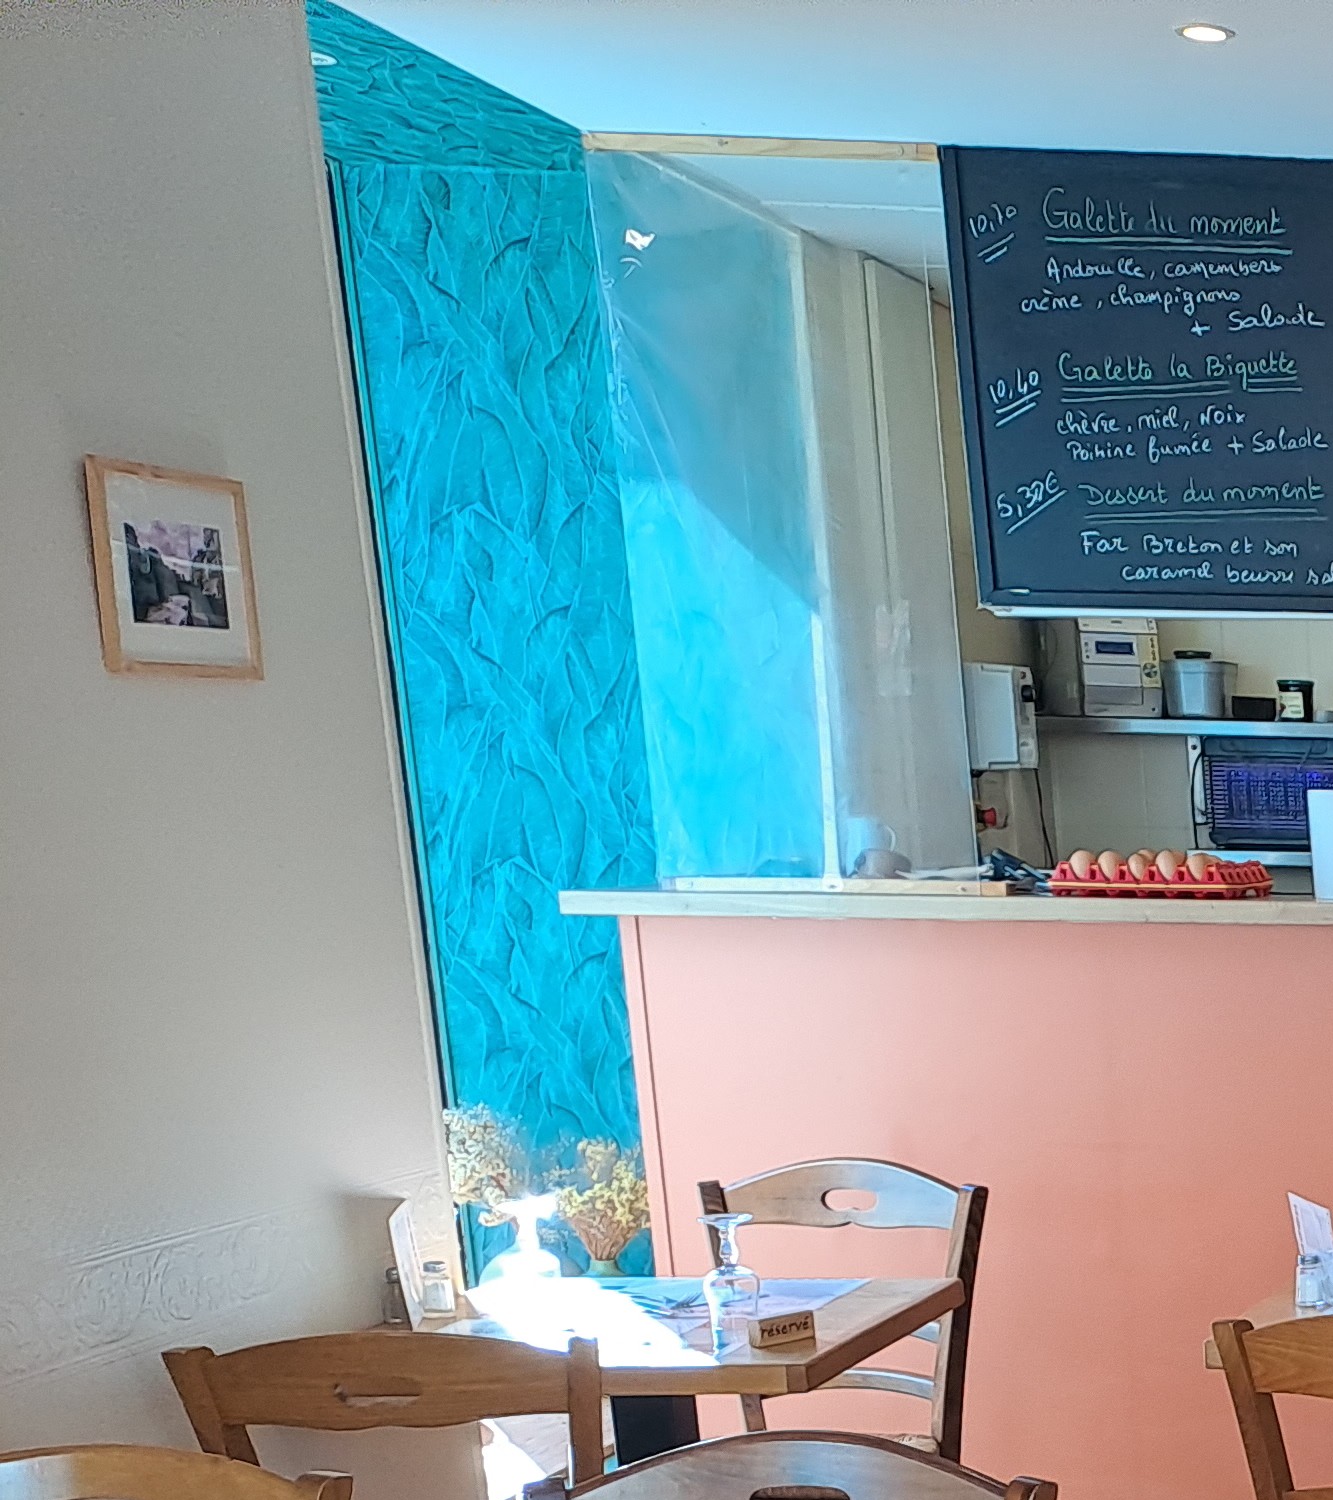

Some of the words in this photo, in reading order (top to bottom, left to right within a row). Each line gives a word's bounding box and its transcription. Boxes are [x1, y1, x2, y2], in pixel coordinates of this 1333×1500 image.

[1042, 187, 1136, 234] Galette
[1149, 201, 1178, 234] du
[1190, 207, 1287, 235] moment
[1058, 351, 1152, 383] Galette
[1170, 353, 1193, 380] la
[1205, 350, 1299, 391] Biquette
[1077, 480, 1169, 506] Dessert
[1182, 476, 1216, 503] du
[1222, 475, 1326, 503] moment
[1080, 530, 1129, 556] Far
[1142, 533, 1223, 556] Breton
[1230, 536, 1254, 556] et
[1263, 540, 1299, 558] son
[1121, 562, 1215, 582] caramel
